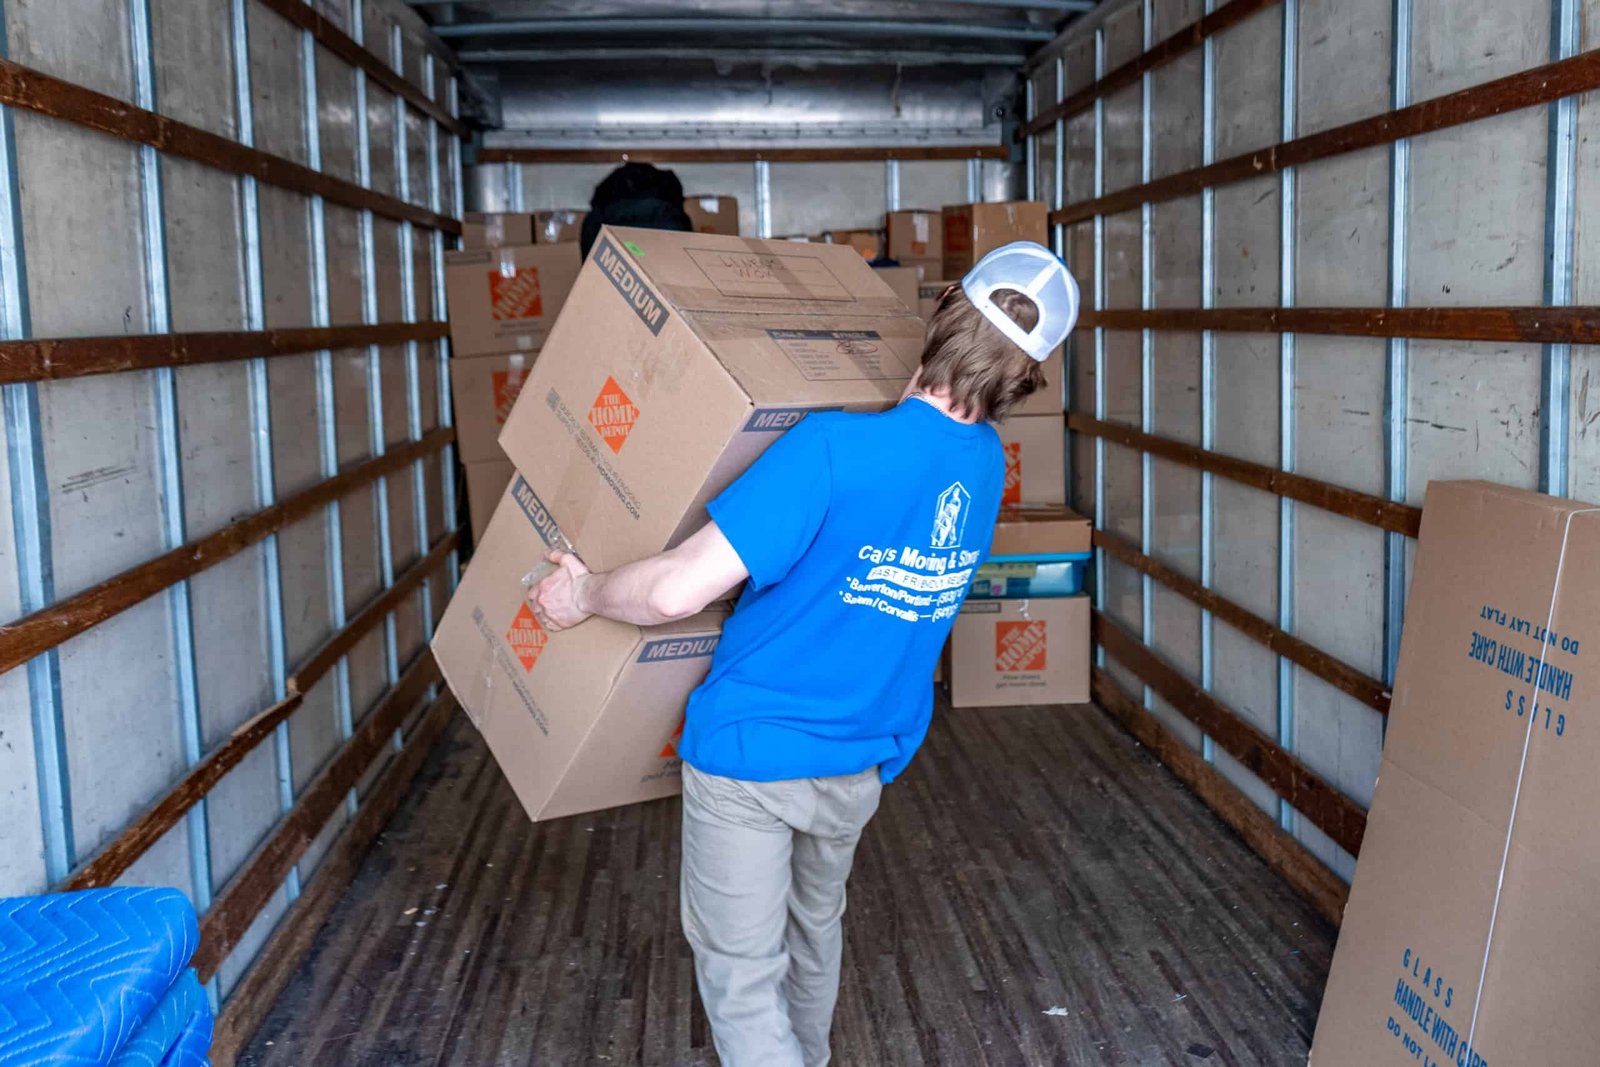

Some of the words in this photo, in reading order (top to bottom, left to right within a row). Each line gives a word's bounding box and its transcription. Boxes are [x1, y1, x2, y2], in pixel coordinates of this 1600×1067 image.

[600, 246, 661, 326] MEDIUM
[591, 404, 637, 426] HOME
[602, 393, 620, 405] THE
[600, 423, 629, 438] DEPOT
[753, 411, 807, 428] MED
[517, 483, 561, 546] MEDIU
[1480, 605, 1506, 626] FLAT
[1509, 617, 1531, 636] LAY
[510, 628, 544, 647] HOME
[997, 620, 1045, 671] HOME
[1468, 632, 1497, 666] CARE
[1561, 636, 1579, 655] DO
[1497, 644, 1525, 680] WITH
[1525, 656, 1573, 701] HANDLE
[1403, 948, 1453, 1008] GLASS
[1394, 978, 1433, 1034] HANDLE
[1431, 1013, 1459, 1060] WITH
[1386, 1016, 1400, 1037] DO
[1402, 1032, 1423, 1060] NOT
